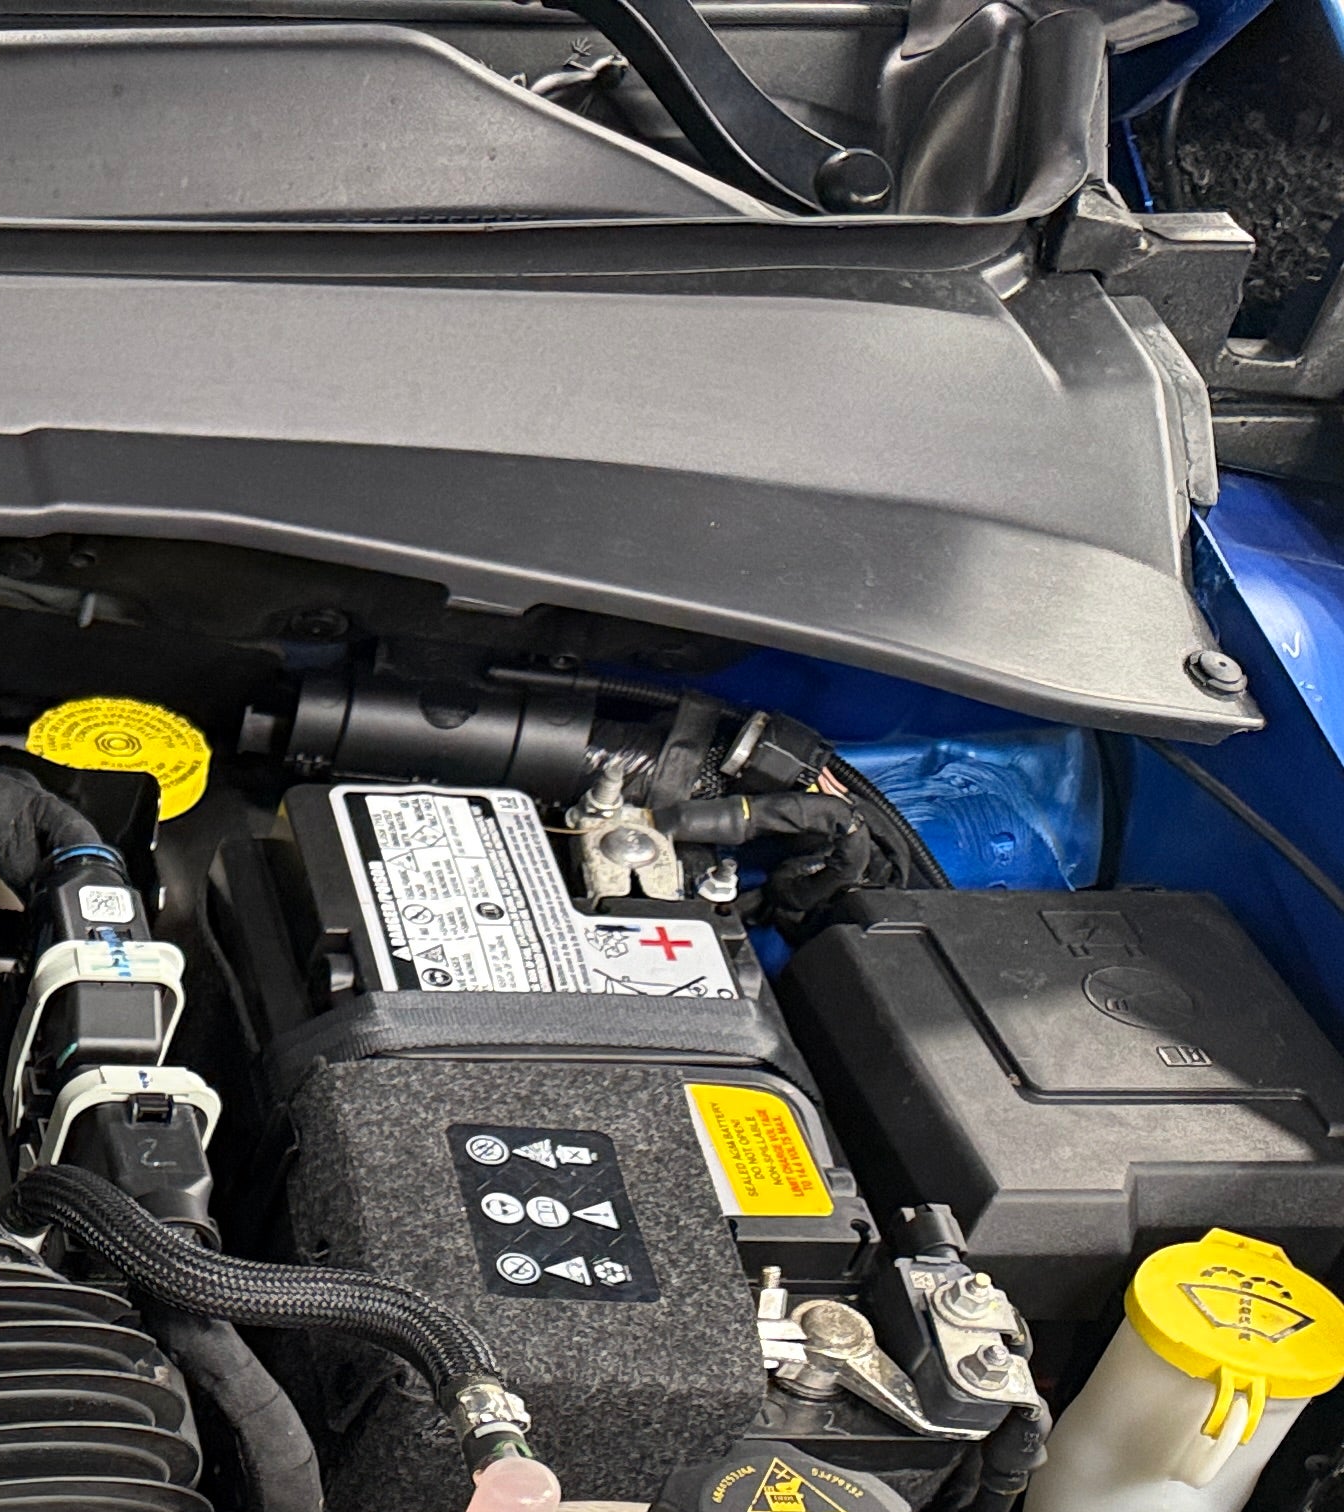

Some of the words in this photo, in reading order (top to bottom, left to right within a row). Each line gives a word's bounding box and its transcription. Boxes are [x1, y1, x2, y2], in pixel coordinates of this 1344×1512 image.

[711, 1102, 733, 1140] BATTERY
[727, 1140, 741, 1160] AGM
[742, 1147, 758, 1164] NOT
[745, 1115, 783, 1185] NON-SPILLABLE
[772, 1144, 793, 1174] CHARGE
[736, 1162, 758, 1197] SEALED
[750, 1166, 764, 1179] DO
[786, 1175, 804, 1197] LIMIT
[800, 1180, 813, 1190] TO
